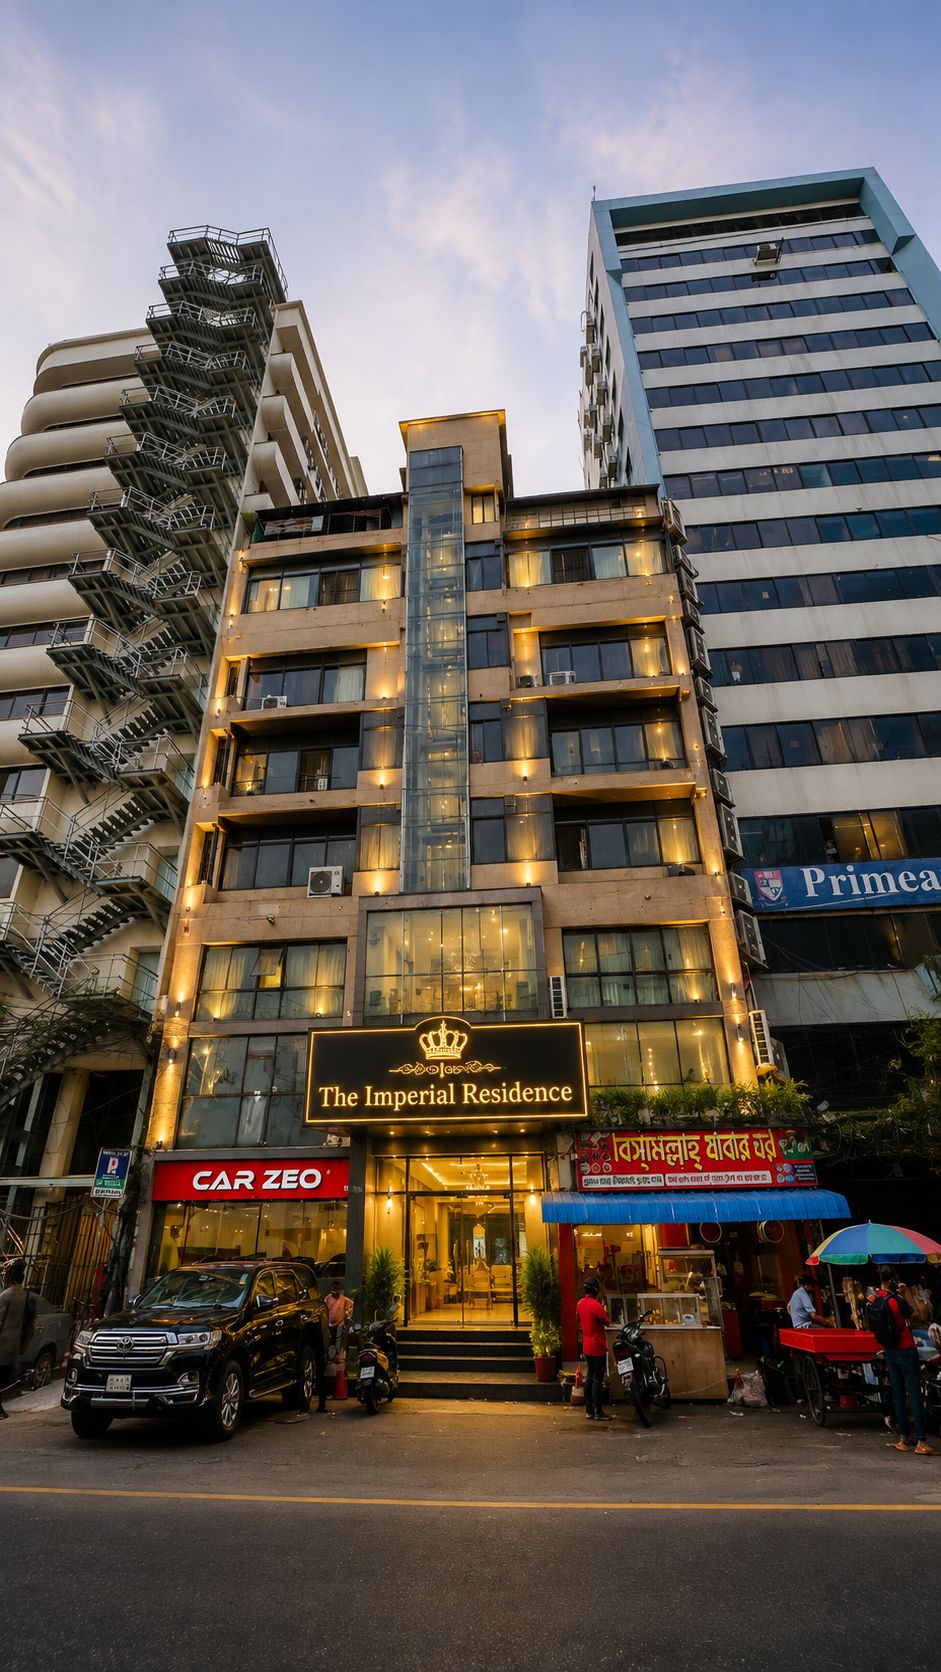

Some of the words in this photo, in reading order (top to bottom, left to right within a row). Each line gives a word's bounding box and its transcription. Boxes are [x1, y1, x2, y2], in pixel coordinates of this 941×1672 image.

[800, 864, 941, 897] Primea
[318, 1086, 359, 1107] The
[364, 1083, 456, 1111] Imperial
[461, 1081, 573, 1104] Residence
[192, 1170, 255, 1191] CAR
[262, 1168, 322, 1190] ZEO
